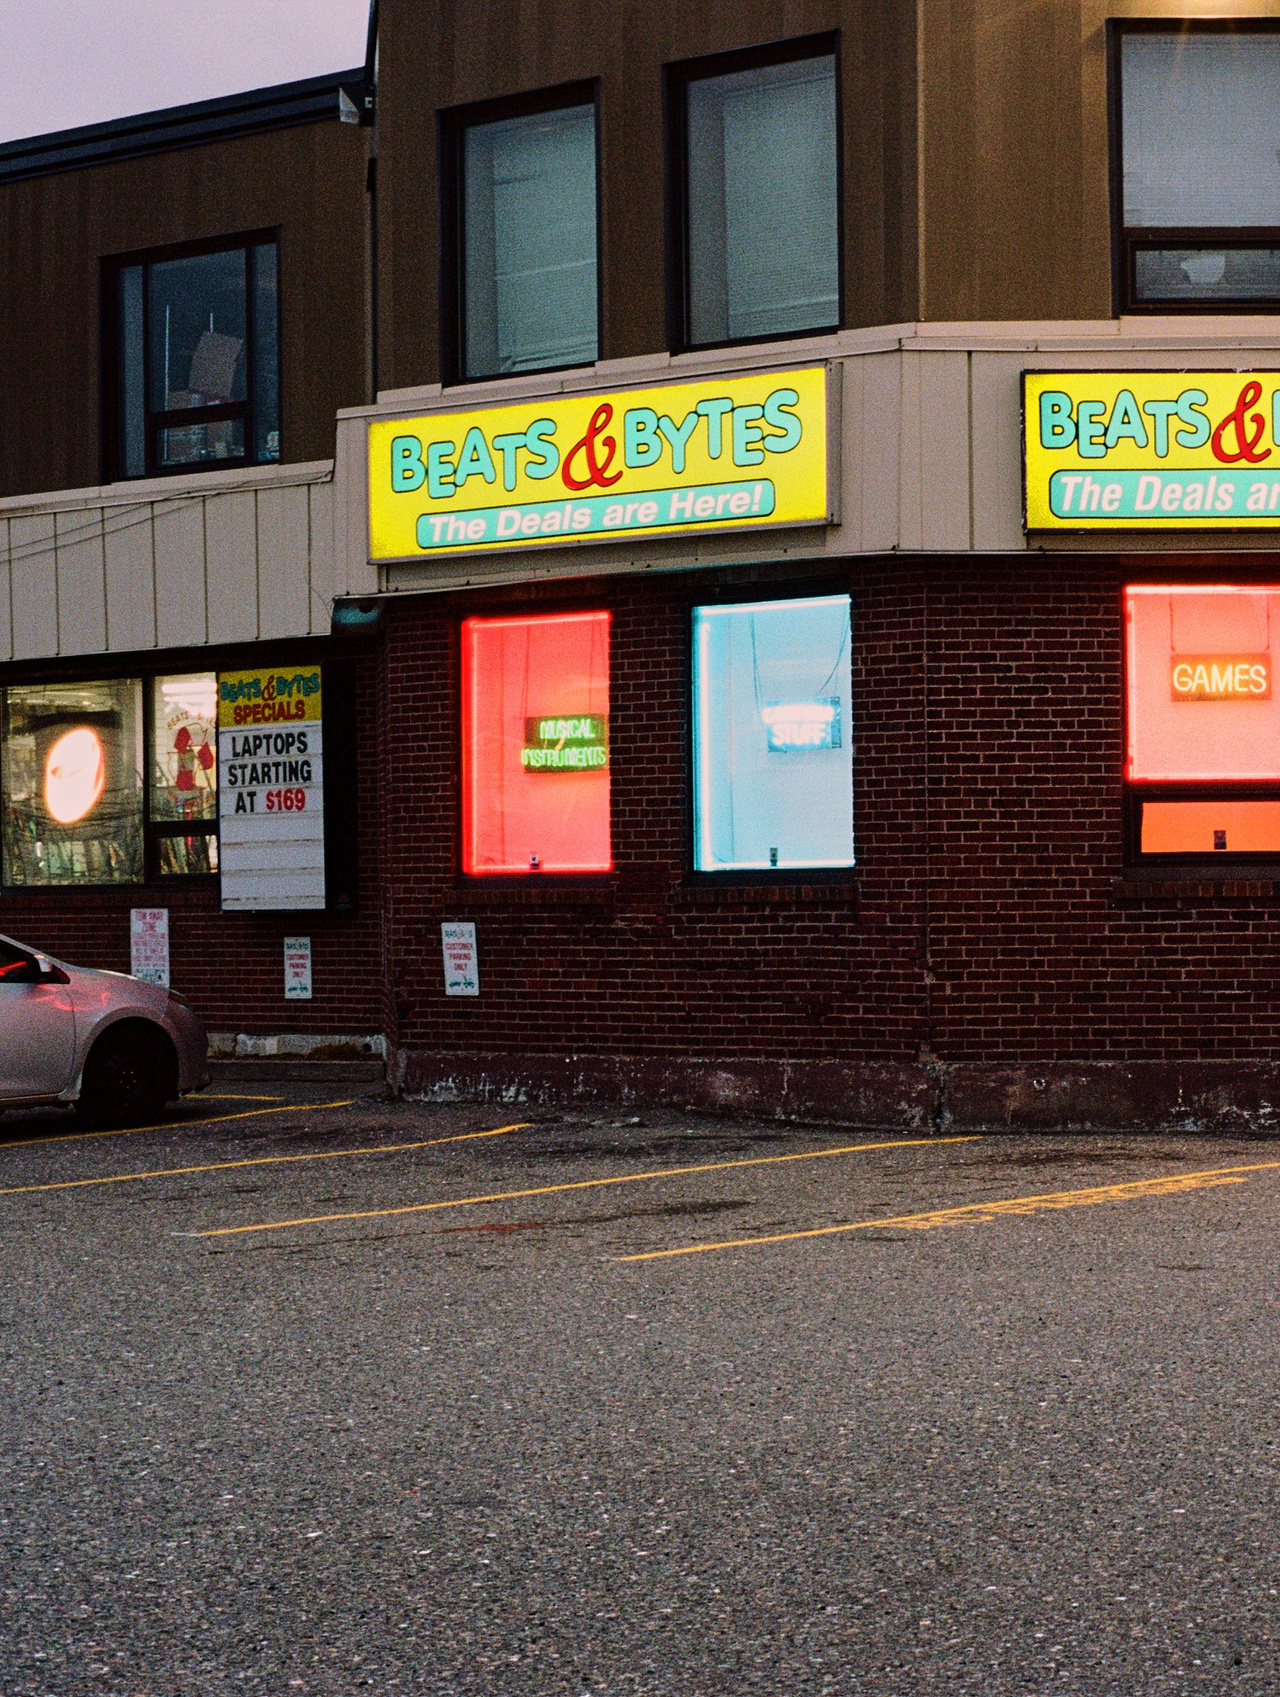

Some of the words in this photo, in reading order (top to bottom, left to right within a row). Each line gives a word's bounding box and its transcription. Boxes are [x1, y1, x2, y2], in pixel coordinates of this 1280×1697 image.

[1039, 388, 1211, 459] BEATS
[1211, 380, 1272, 464] &
[390, 418, 561, 499] BEATS
[561, 403, 623, 491] &
[623, 387, 804, 474] BYTES
[1060, 475, 1121, 512] The
[1133, 475, 1234, 511] Deals
[429, 514, 486, 544] The
[495, 502, 591, 538] Deals
[602, 496, 659, 527] are
[669, 484, 763, 521] Here!
[219, 677, 262, 703] BEATS
[261, 674, 277, 702] &
[276, 672, 320, 698] BYTES
[1172, 663, 1267, 693] GAMES
[233, 700, 306, 725] SPECIALS
[539, 718, 596, 740] MUSICAL
[772, 722, 827, 746] STUFF
[231, 732, 308, 758] LAPTOPS
[520, 746, 607, 768] INSTRUMENTS
[227, 760, 312, 786] STARTING
[234, 790, 257, 814] AT
[265, 787, 306, 813] $169
